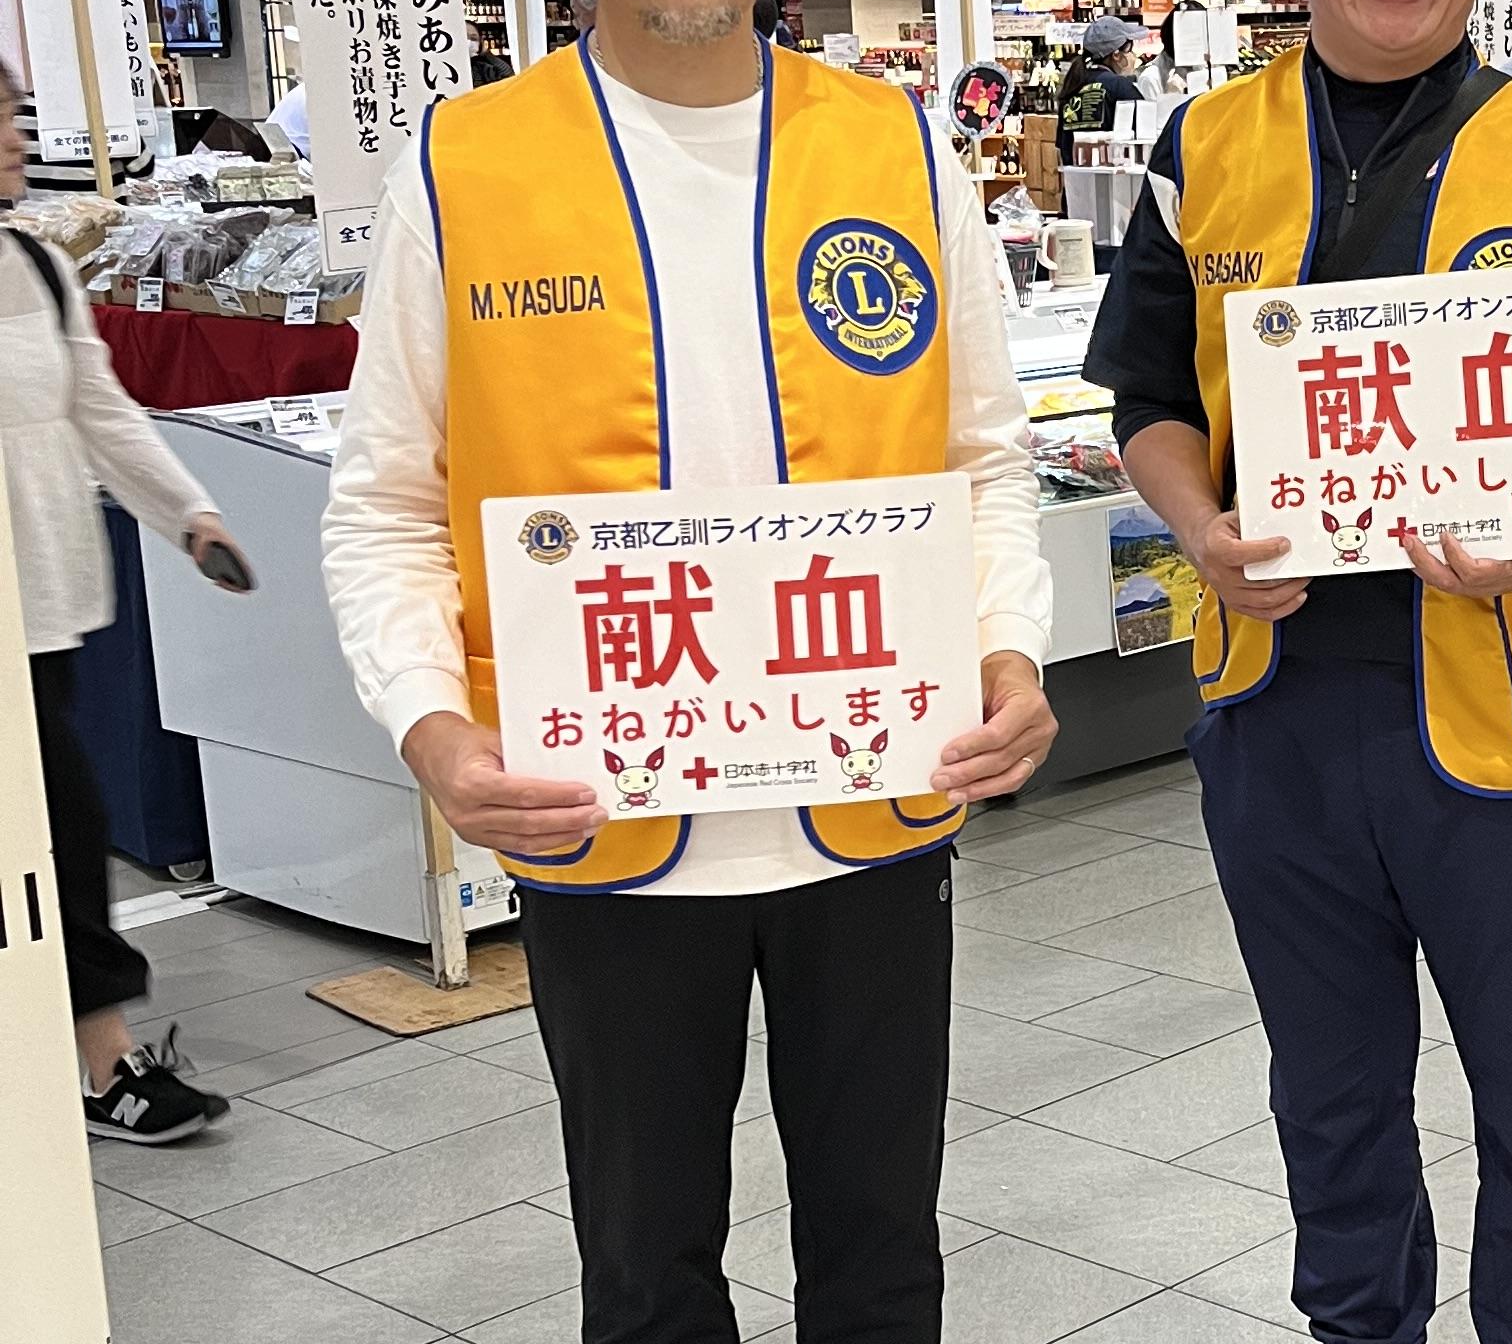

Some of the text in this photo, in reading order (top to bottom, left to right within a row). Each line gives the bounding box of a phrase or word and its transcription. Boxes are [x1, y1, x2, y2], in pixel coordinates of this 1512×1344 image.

[821, 236, 891, 266] LIONS
[469, 274, 606, 322] M.YASUDA
[847, 270, 886, 316] L
[843, 325, 910, 349] INTERNATIONAL
[589, 500, 937, 552] 京都乙訓ライオンズクラブ
[1422, 518, 1502, 538] 日本赤十字社
[574, 553, 898, 693] 献血
[540, 679, 941, 751] おねがいします
[724, 758, 818, 780] 日本赤十字社
